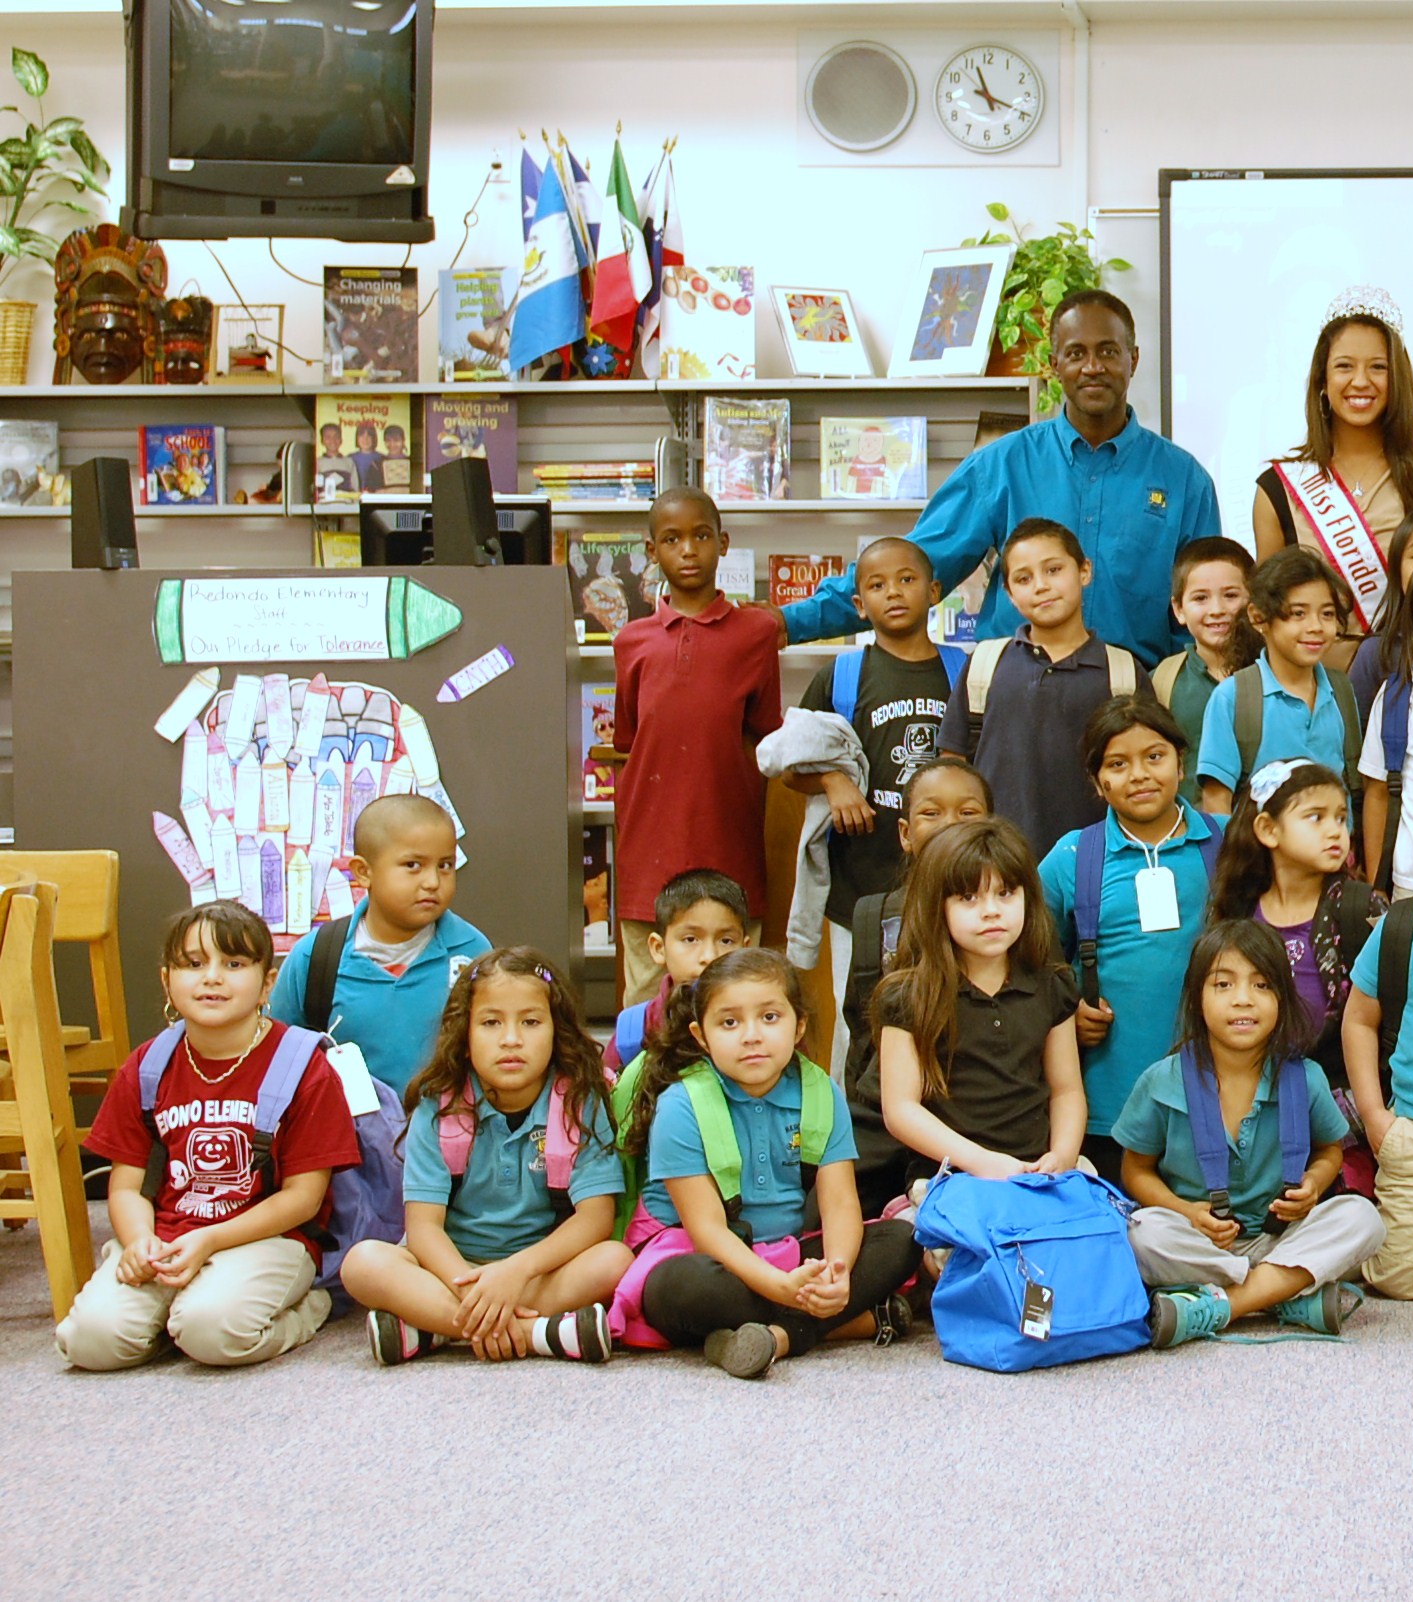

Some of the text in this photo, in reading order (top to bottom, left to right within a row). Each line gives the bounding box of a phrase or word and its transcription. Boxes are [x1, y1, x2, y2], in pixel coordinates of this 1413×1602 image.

[965, 58, 974, 69] 11
[983, 53, 994, 65] 12
[949, 73, 960, 84] 10
[1018, 73, 1025, 84] 2
[946, 92, 953, 103] 9
[951, 111, 958, 122] 8
[966, 125, 973, 135] 7
[983, 130, 991, 141] 6
[1004, 125, 1011, 135] 5
[340, 279, 402, 294] Changing
[456, 282, 498, 294] Helping
[340, 294, 401, 305] materials
[337, 402, 389, 416] Keeping
[432, 401, 509, 415] Moving and
[338, 416, 387, 429] healthy
[443, 416, 498, 430] growing
[165, 435, 212, 450] SCHOOL
[1300, 470, 1336, 516] Miss
[581, 543, 603, 554] Life
[1326, 514, 1378, 596] Florida
[190, 583, 369, 608] Redondo Elementary
[777, 584, 808, 596] Great
[190, 634, 386, 658] Our Pledge for Tolerance
[871, 699, 914, 728] REDONDO
